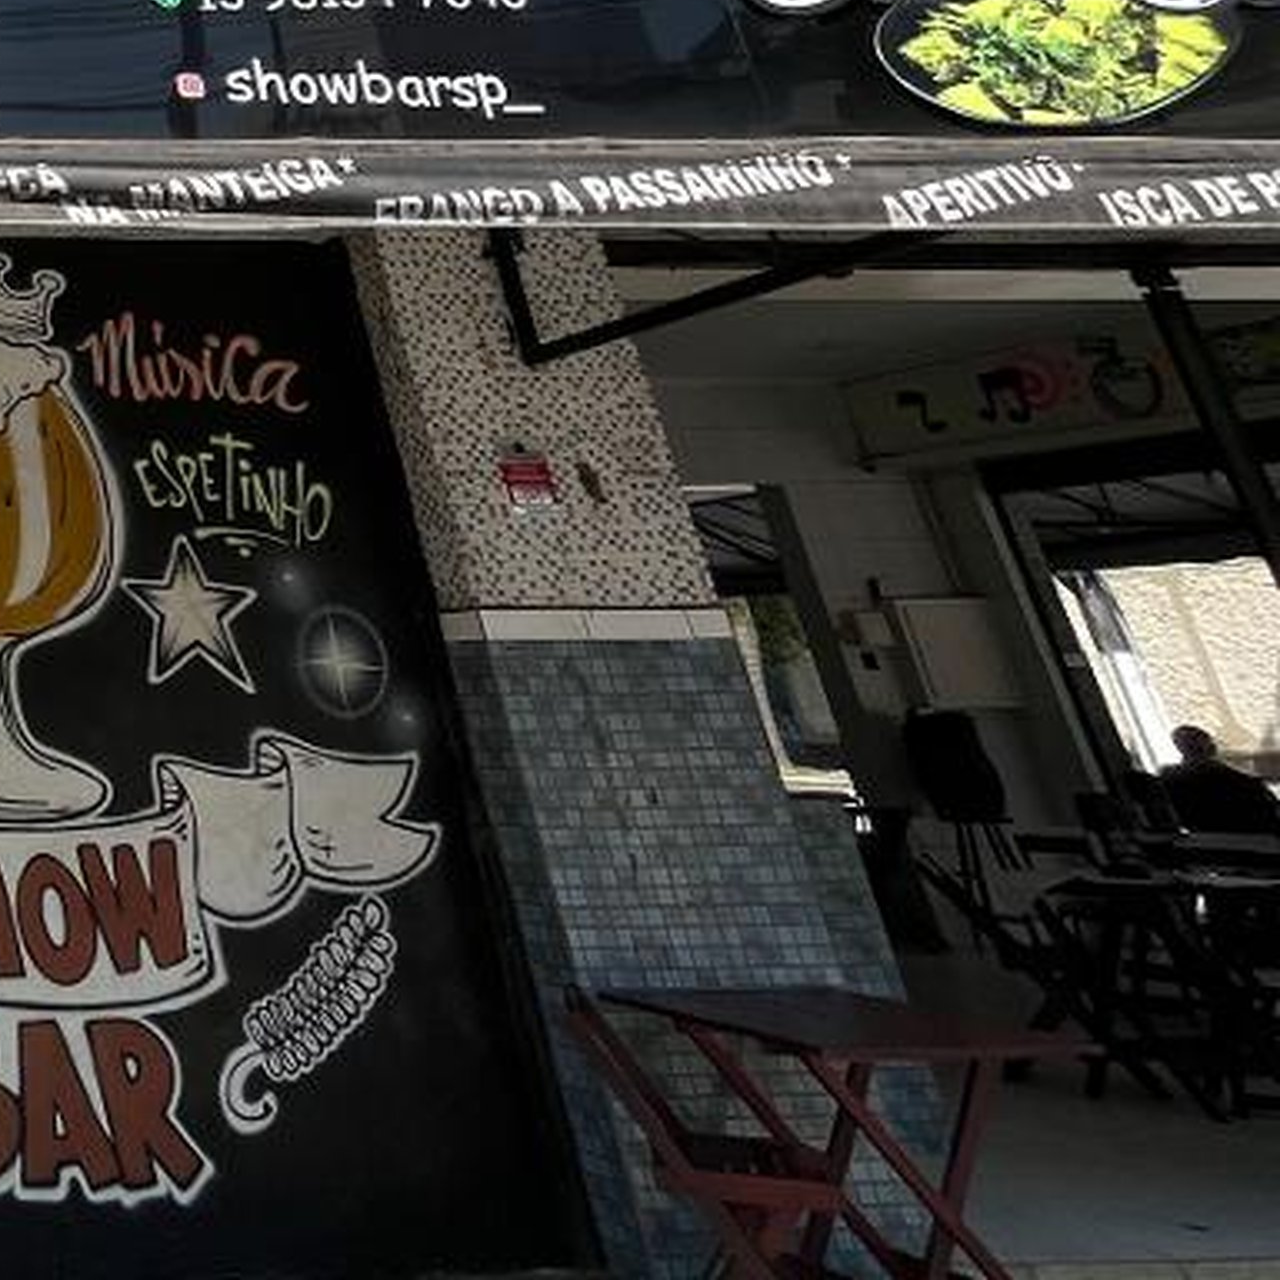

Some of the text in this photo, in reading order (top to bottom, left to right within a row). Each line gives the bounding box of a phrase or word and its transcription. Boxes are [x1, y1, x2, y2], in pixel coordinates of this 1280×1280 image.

[224, 56, 546, 120] showbarsp_
[374, 188, 544, 226] FRANGO
[547, 178, 586, 218] A
[579, 150, 836, 213] PASSARINHO
[881, 156, 1074, 230] APERITIVO
[1096, 182, 1204, 228] ISCA
[1188, 176, 1261, 218] DE
[1245, 166, 1280, 210] P
[76, 312, 310, 414] Música
